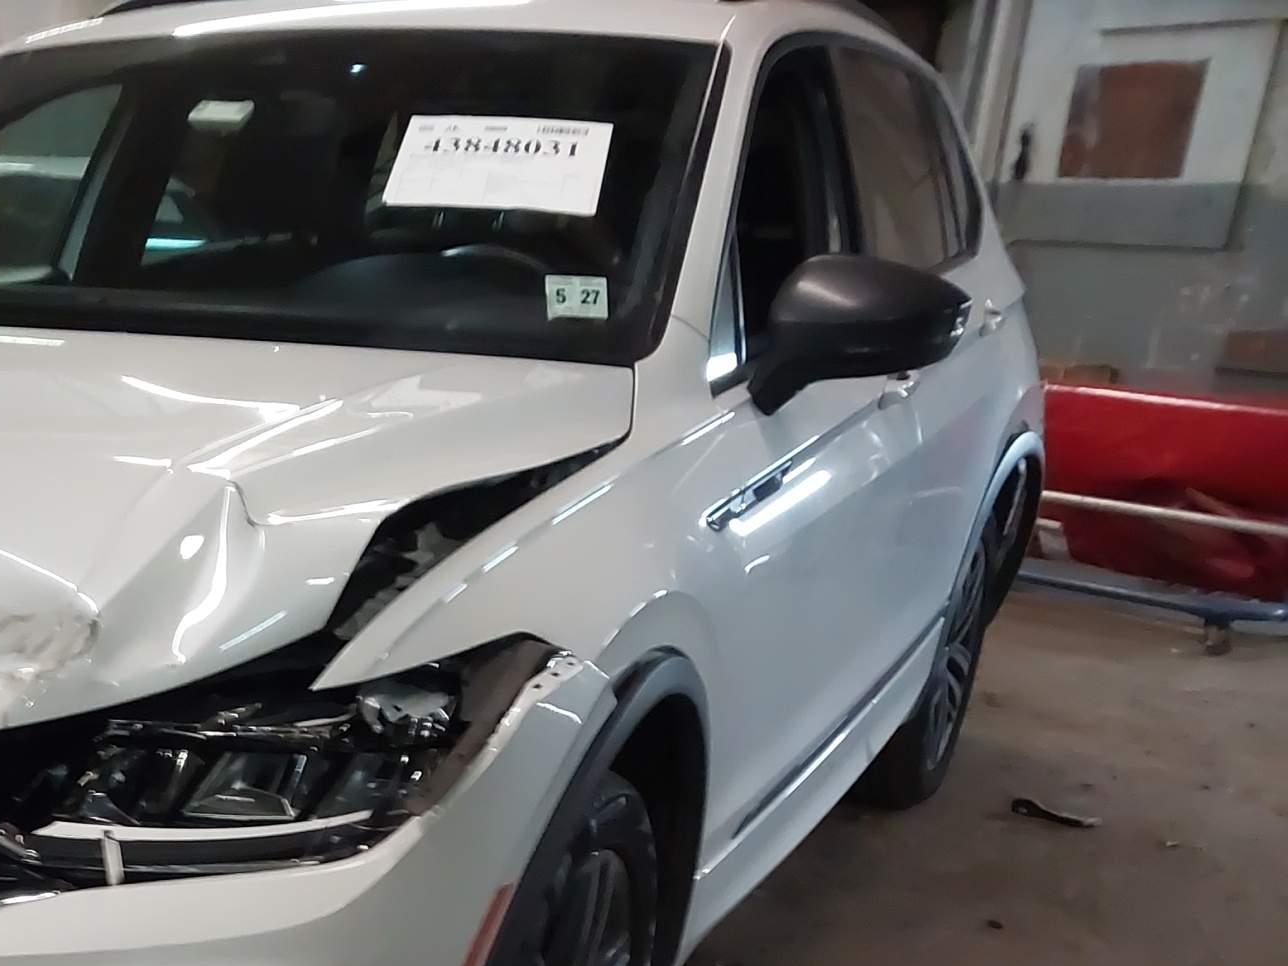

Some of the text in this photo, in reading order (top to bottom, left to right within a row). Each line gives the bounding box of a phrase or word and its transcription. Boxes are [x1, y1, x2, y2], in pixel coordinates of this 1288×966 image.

[424, 136, 579, 157] 43848031
[555, 287, 601, 305] 5 27
